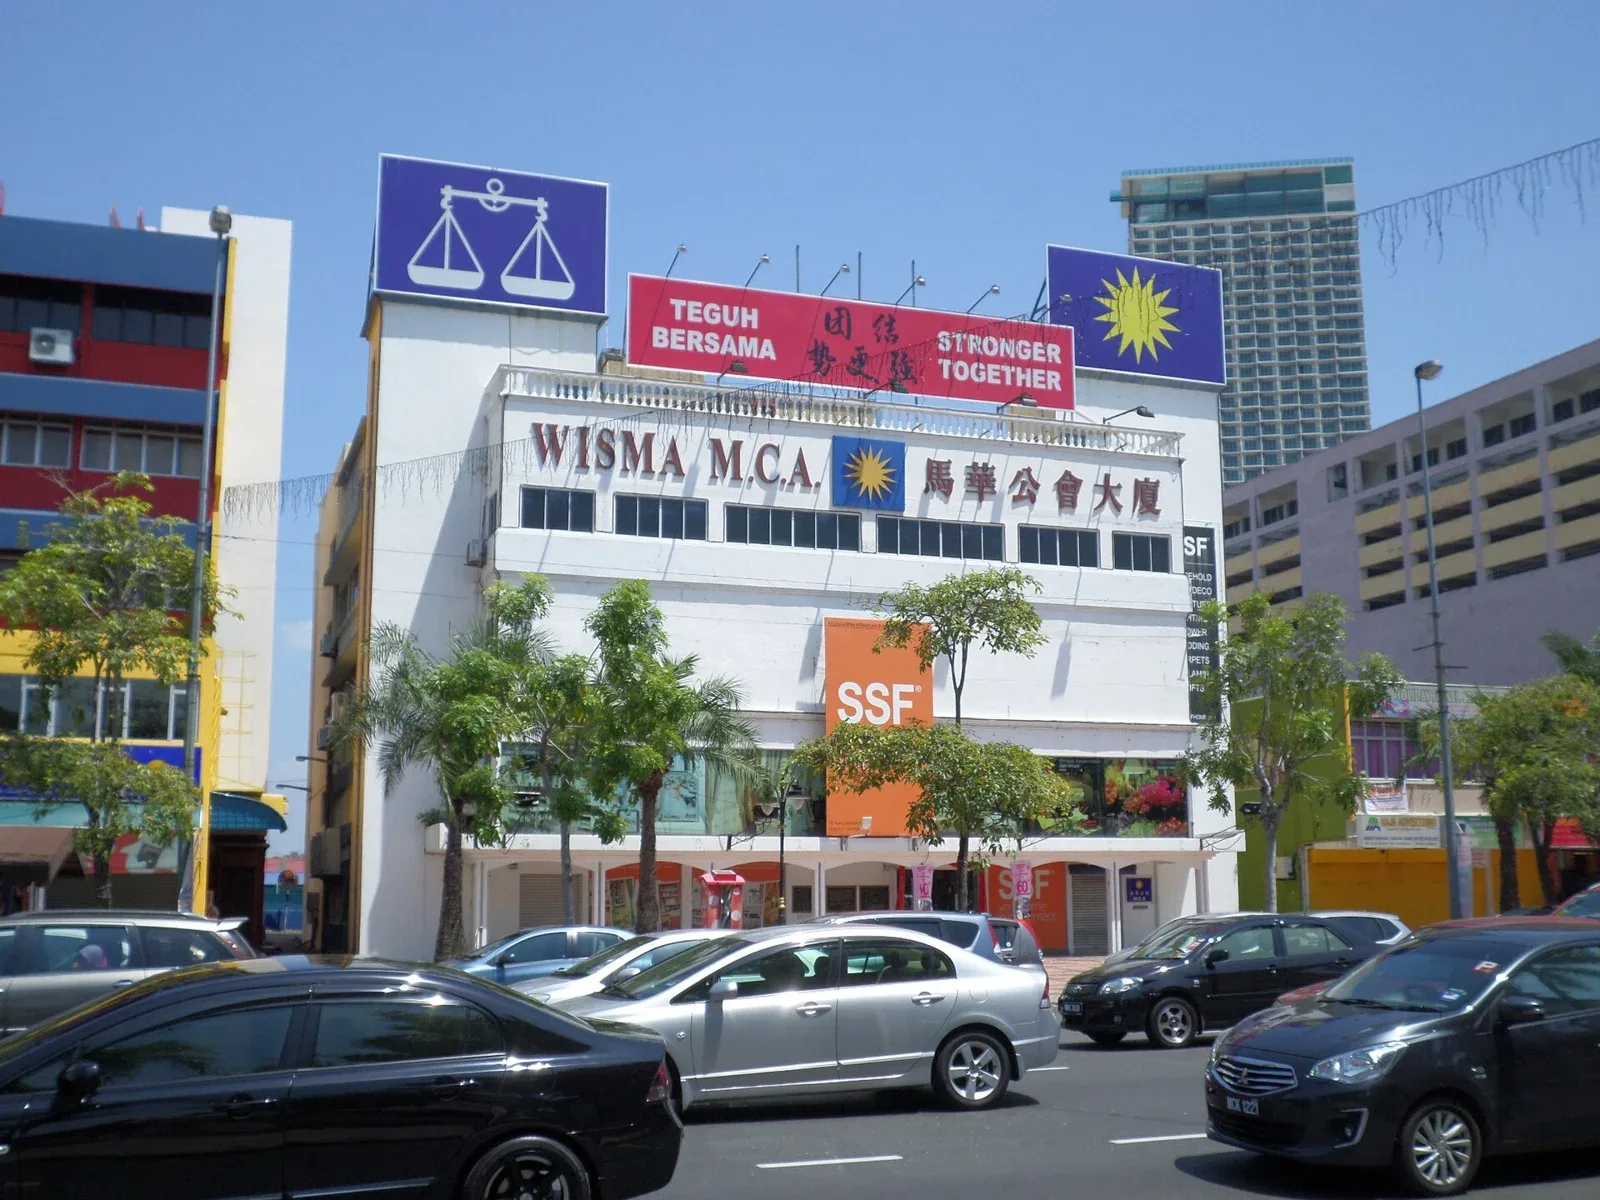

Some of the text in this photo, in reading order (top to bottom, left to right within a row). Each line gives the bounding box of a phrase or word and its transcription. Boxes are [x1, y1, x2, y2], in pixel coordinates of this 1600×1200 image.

[670, 298, 759, 330] TEGUH
[651, 326, 777, 361] BERSAMA
[936, 330, 1062, 365] STRONGER
[938, 358, 1063, 391] TOGETHER
[531, 422, 821, 488] WISMA M.C.A.
[924, 457, 1162, 516] 馬華公會大廈
[837, 681, 915, 725] SSF
